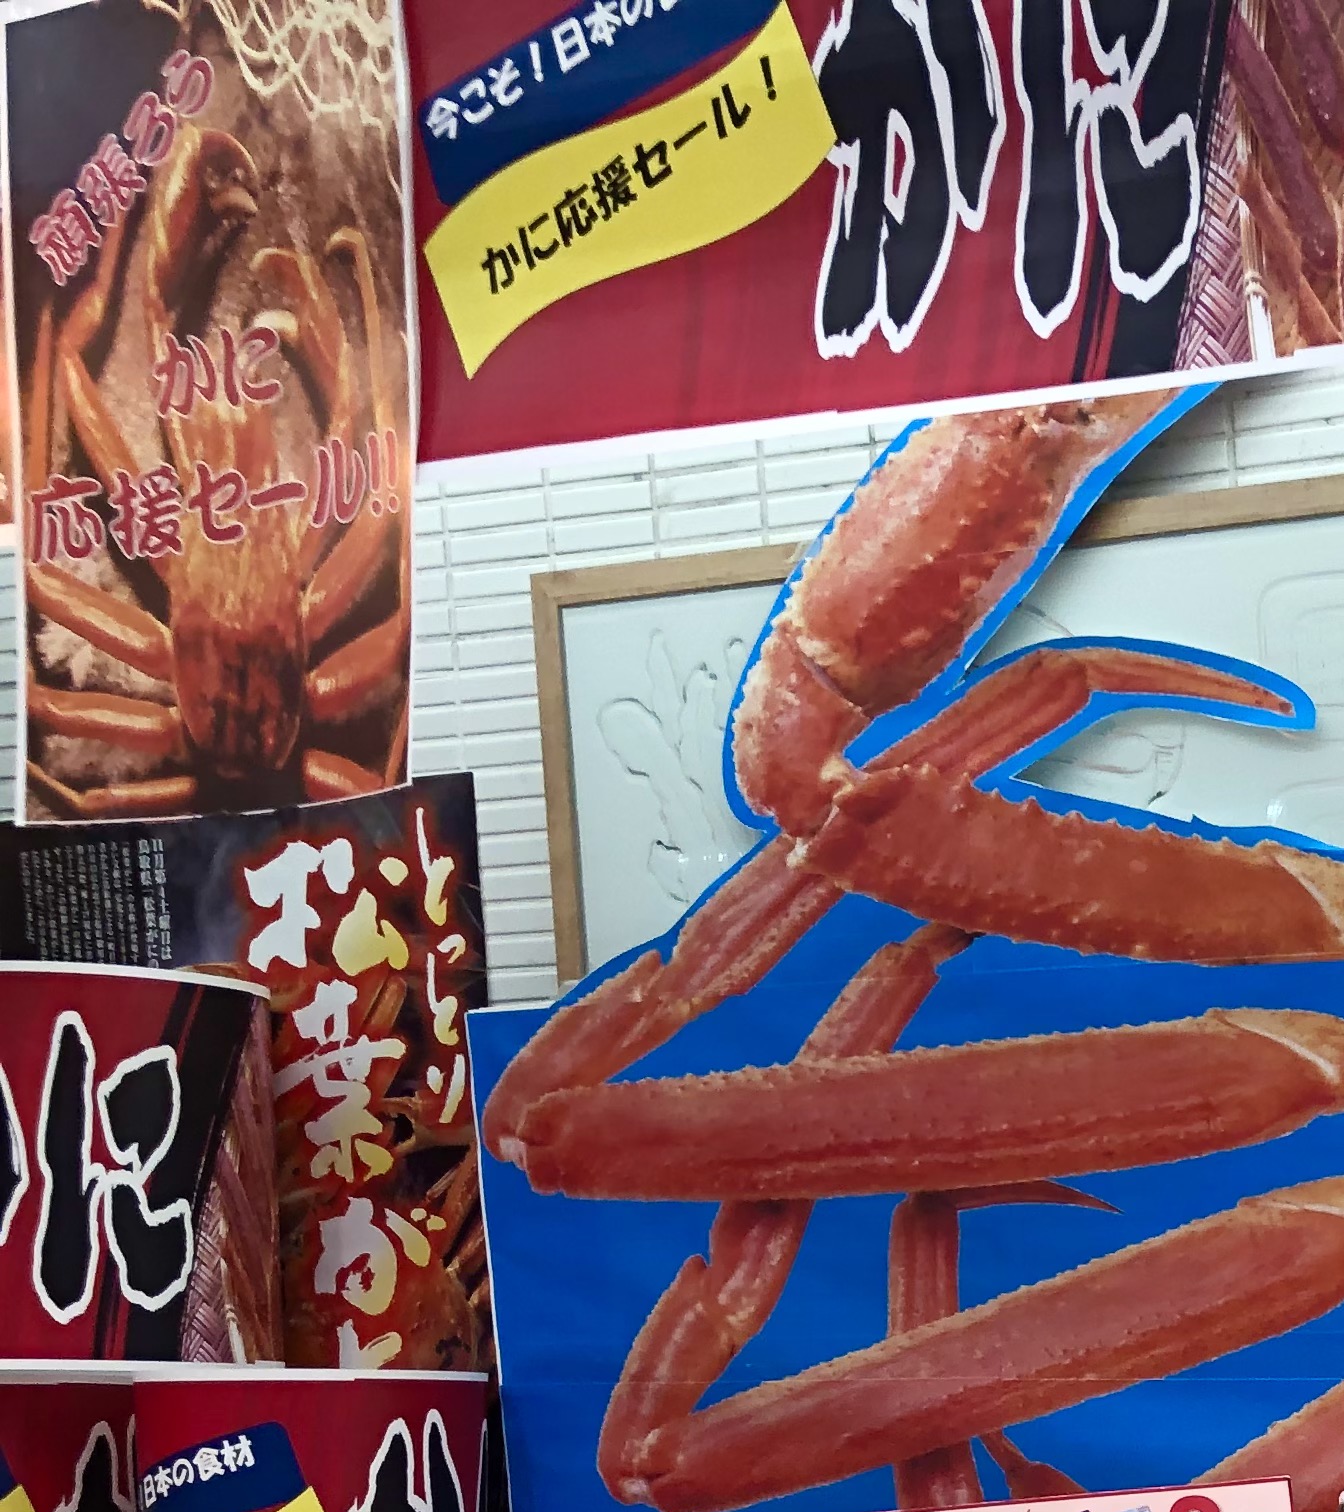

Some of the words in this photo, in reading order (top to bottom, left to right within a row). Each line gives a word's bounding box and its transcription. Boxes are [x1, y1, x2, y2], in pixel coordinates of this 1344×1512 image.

[426, 0, 680, 140] 今こそ！日本の
[28, 50, 214, 286] 頑張ろう
[481, 55, 778, 294] かに応援セール！
[150, 325, 286, 420] かに
[30, 430, 400, 565] 応援セール!!
